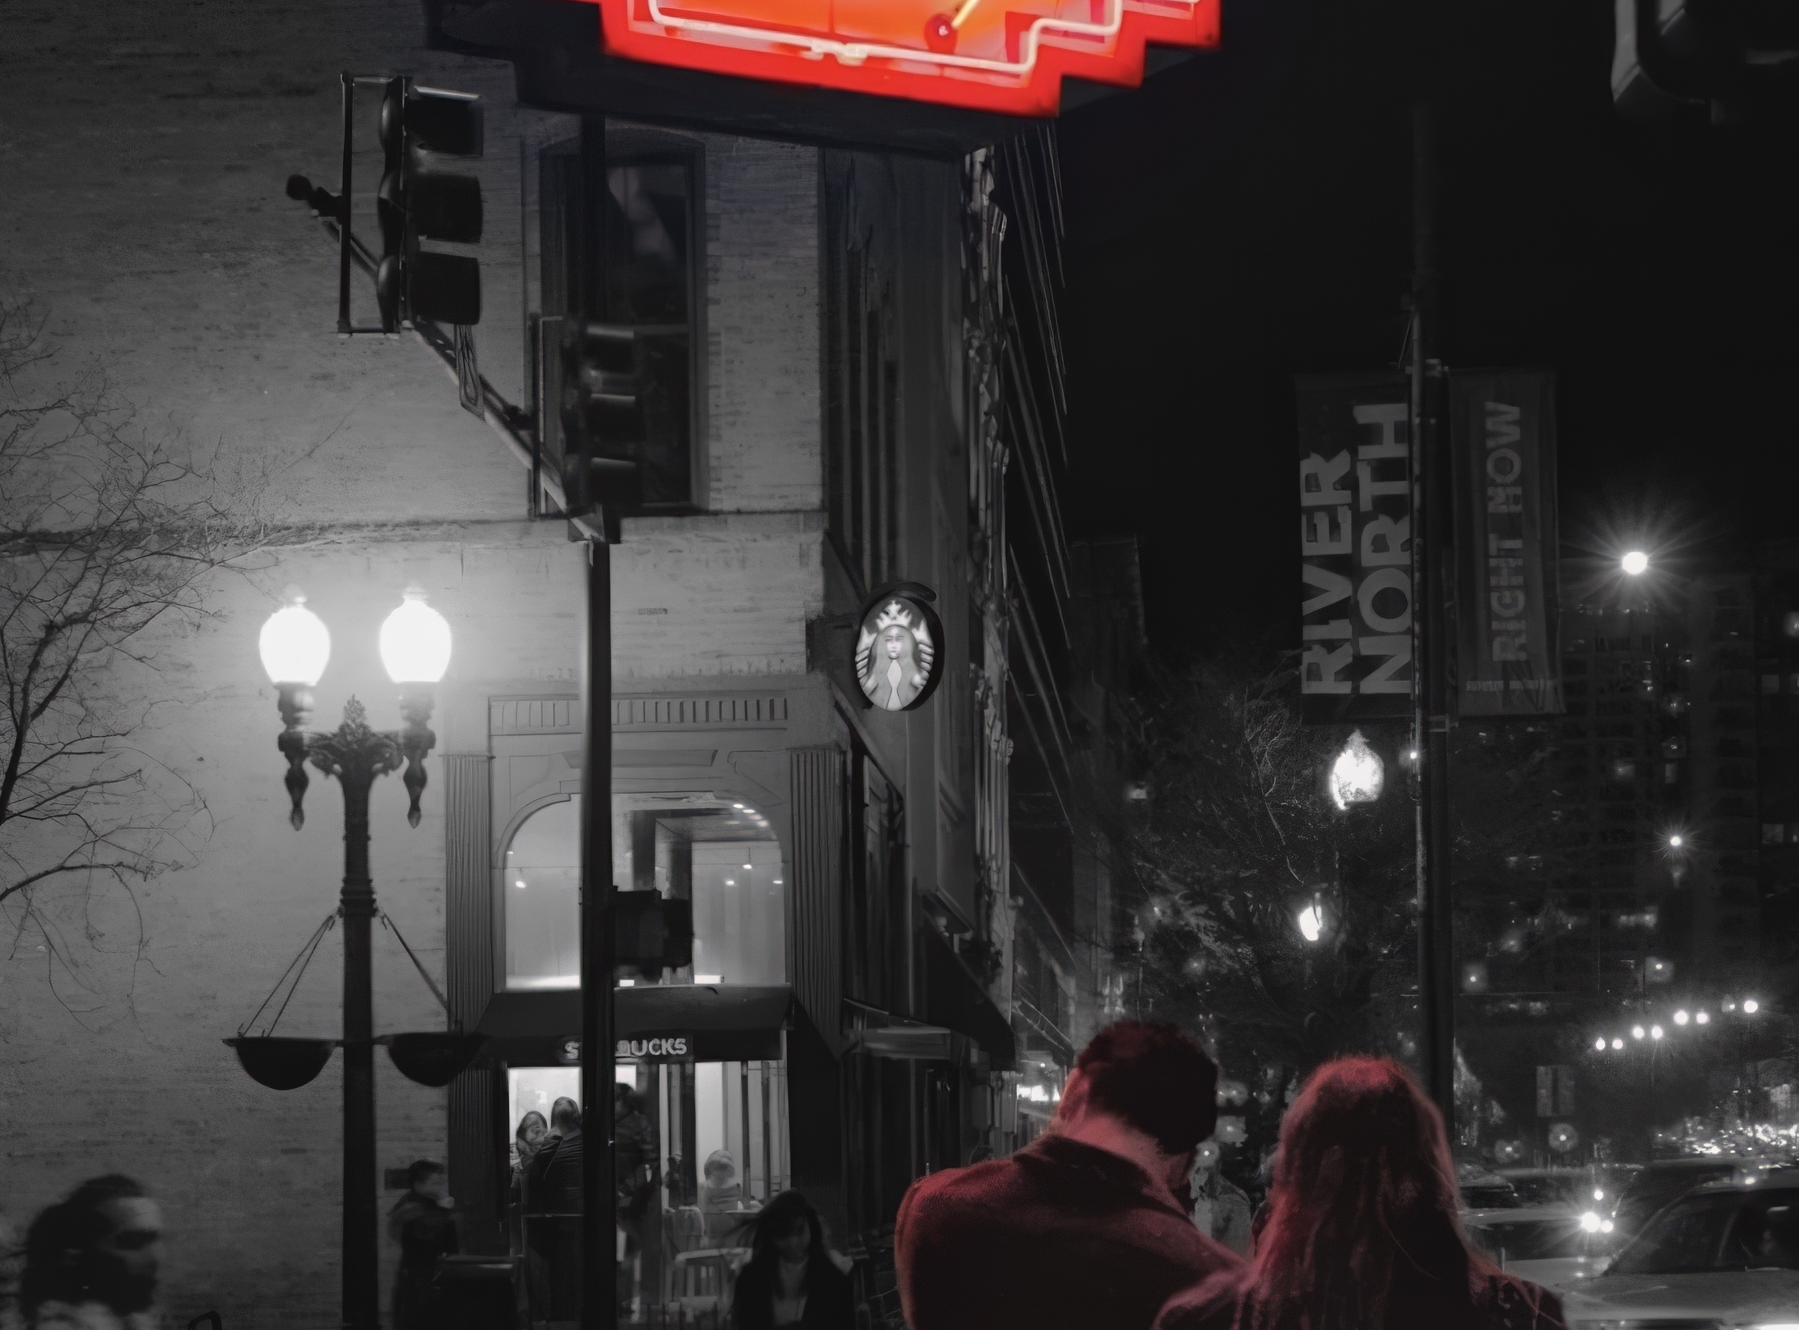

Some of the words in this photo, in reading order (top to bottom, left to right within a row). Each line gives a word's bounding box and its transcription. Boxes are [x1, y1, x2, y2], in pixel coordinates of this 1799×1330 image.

[1352, 402, 1411, 695] NORTH
[1485, 401, 1523, 514] NOW
[1299, 449, 1353, 695] RIVER
[1490, 533, 1528, 662] RIGHT
